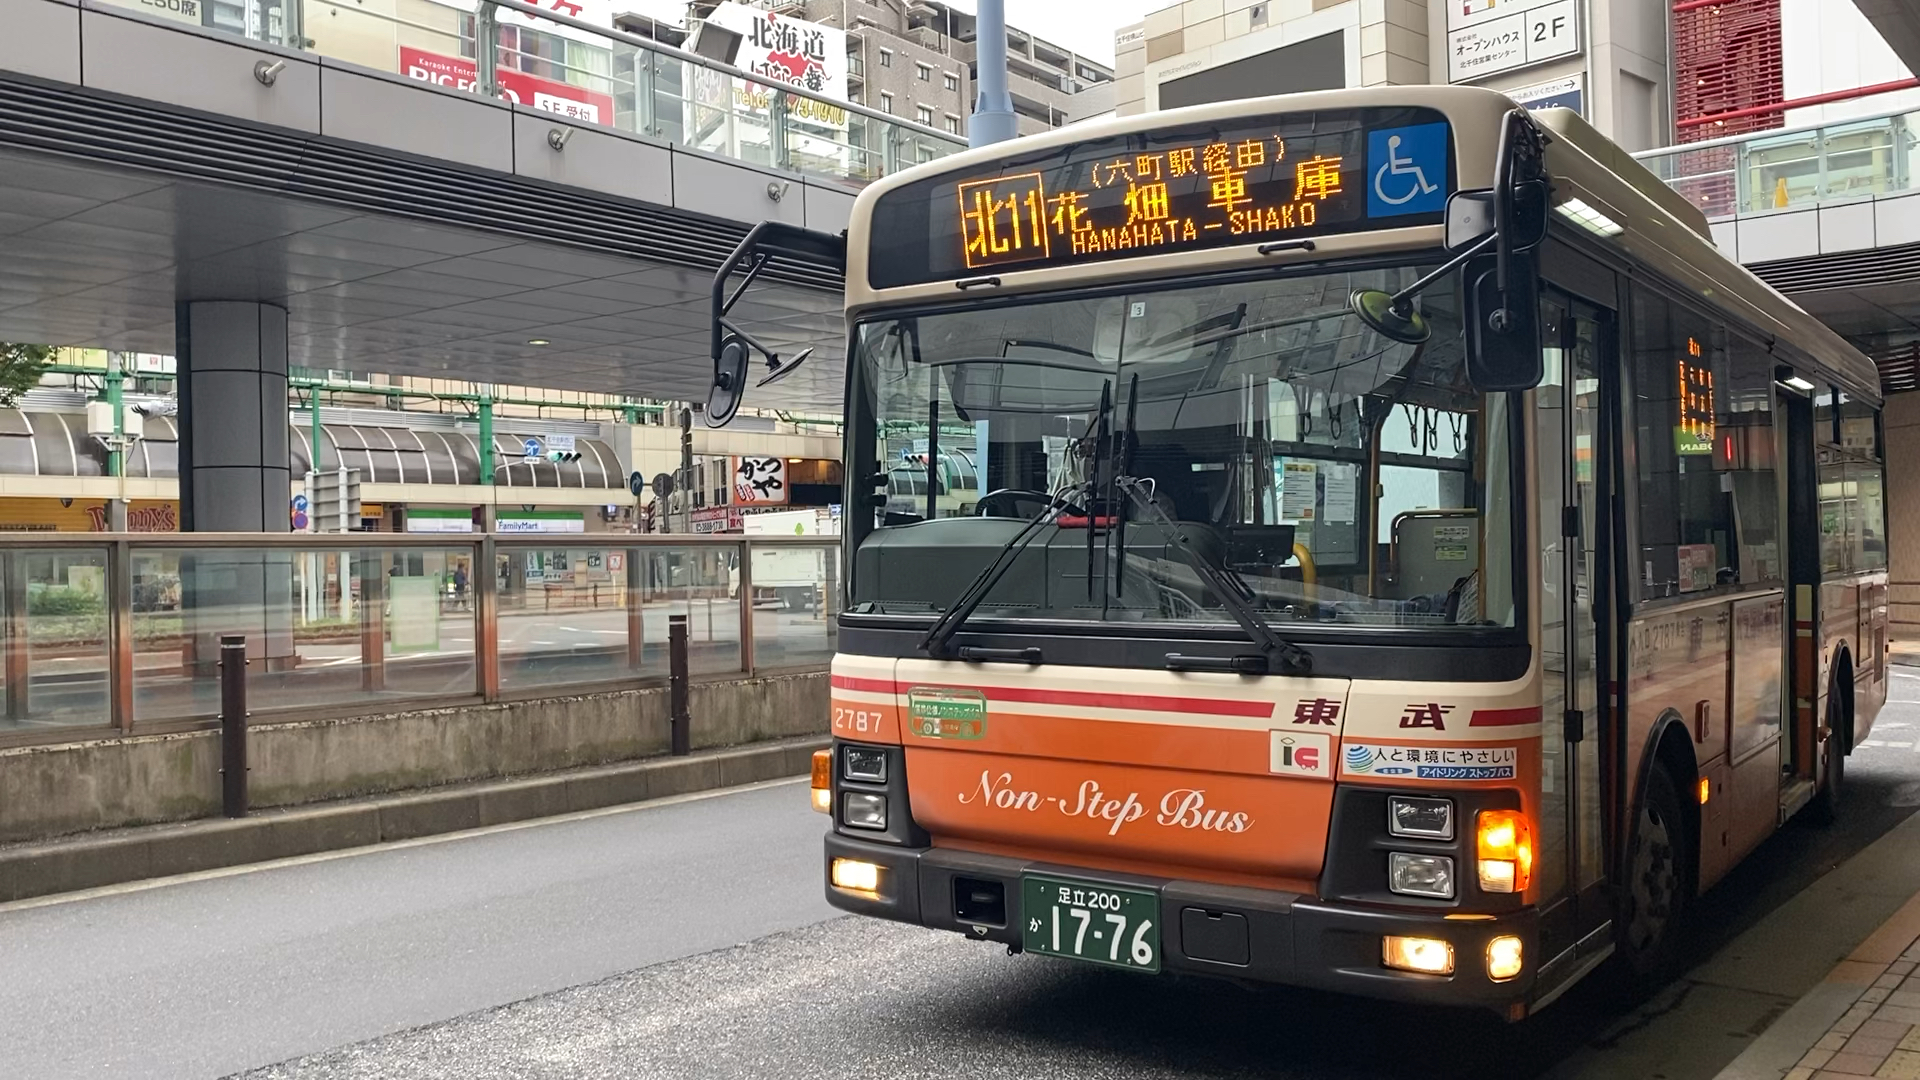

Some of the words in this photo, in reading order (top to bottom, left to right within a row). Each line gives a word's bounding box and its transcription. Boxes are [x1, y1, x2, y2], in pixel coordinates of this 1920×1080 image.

[748, 16, 826, 61] 北海道
[1534, 16, 1566, 42] 2F
[1456, 31, 1520, 56] オープンハウス
[419, 58, 451, 71] Karaoke
[1460, 49, 1517, 69] 北千住営業センター
[566, 105, 591, 121] 受付
[966, 188, 1041, 258] 北11
[498, 521, 539, 531] FamilyMart
[835, 707, 883, 734] 2787
[1374, 748, 1516, 764] 人と環境にやさしい
[958, 769, 1149, 836] Non-Step
[1156, 788, 1255, 834] Bus
[1058, 886, 1121, 911] 足立200
[1029, 917, 1042, 933] か
[1052, 905, 1153, 966] 17-76
